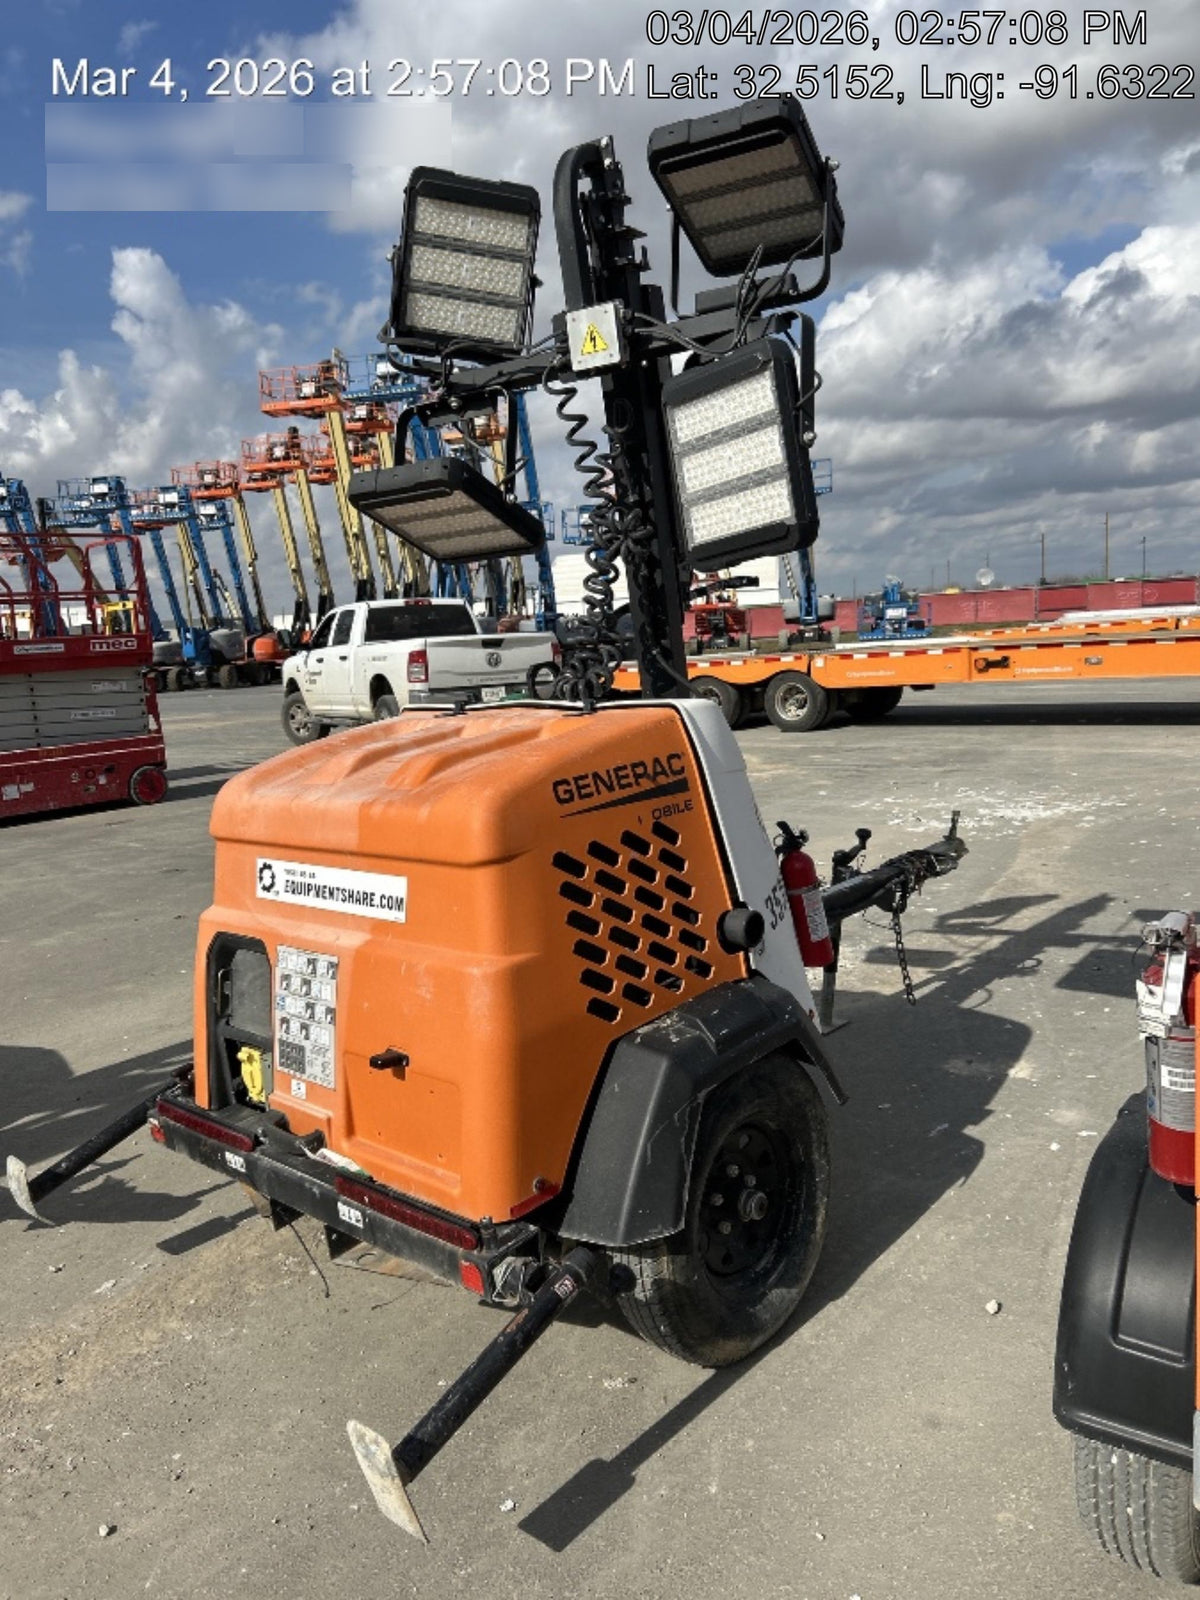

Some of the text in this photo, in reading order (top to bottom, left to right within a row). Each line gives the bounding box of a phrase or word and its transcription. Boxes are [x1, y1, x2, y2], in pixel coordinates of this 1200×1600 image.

[90, 638, 137, 650] mec
[552, 752, 686, 805] GENERAC
[637, 799, 694, 825] OBILE
[283, 879, 404, 912] EQUIPMENTSHARE.COM
